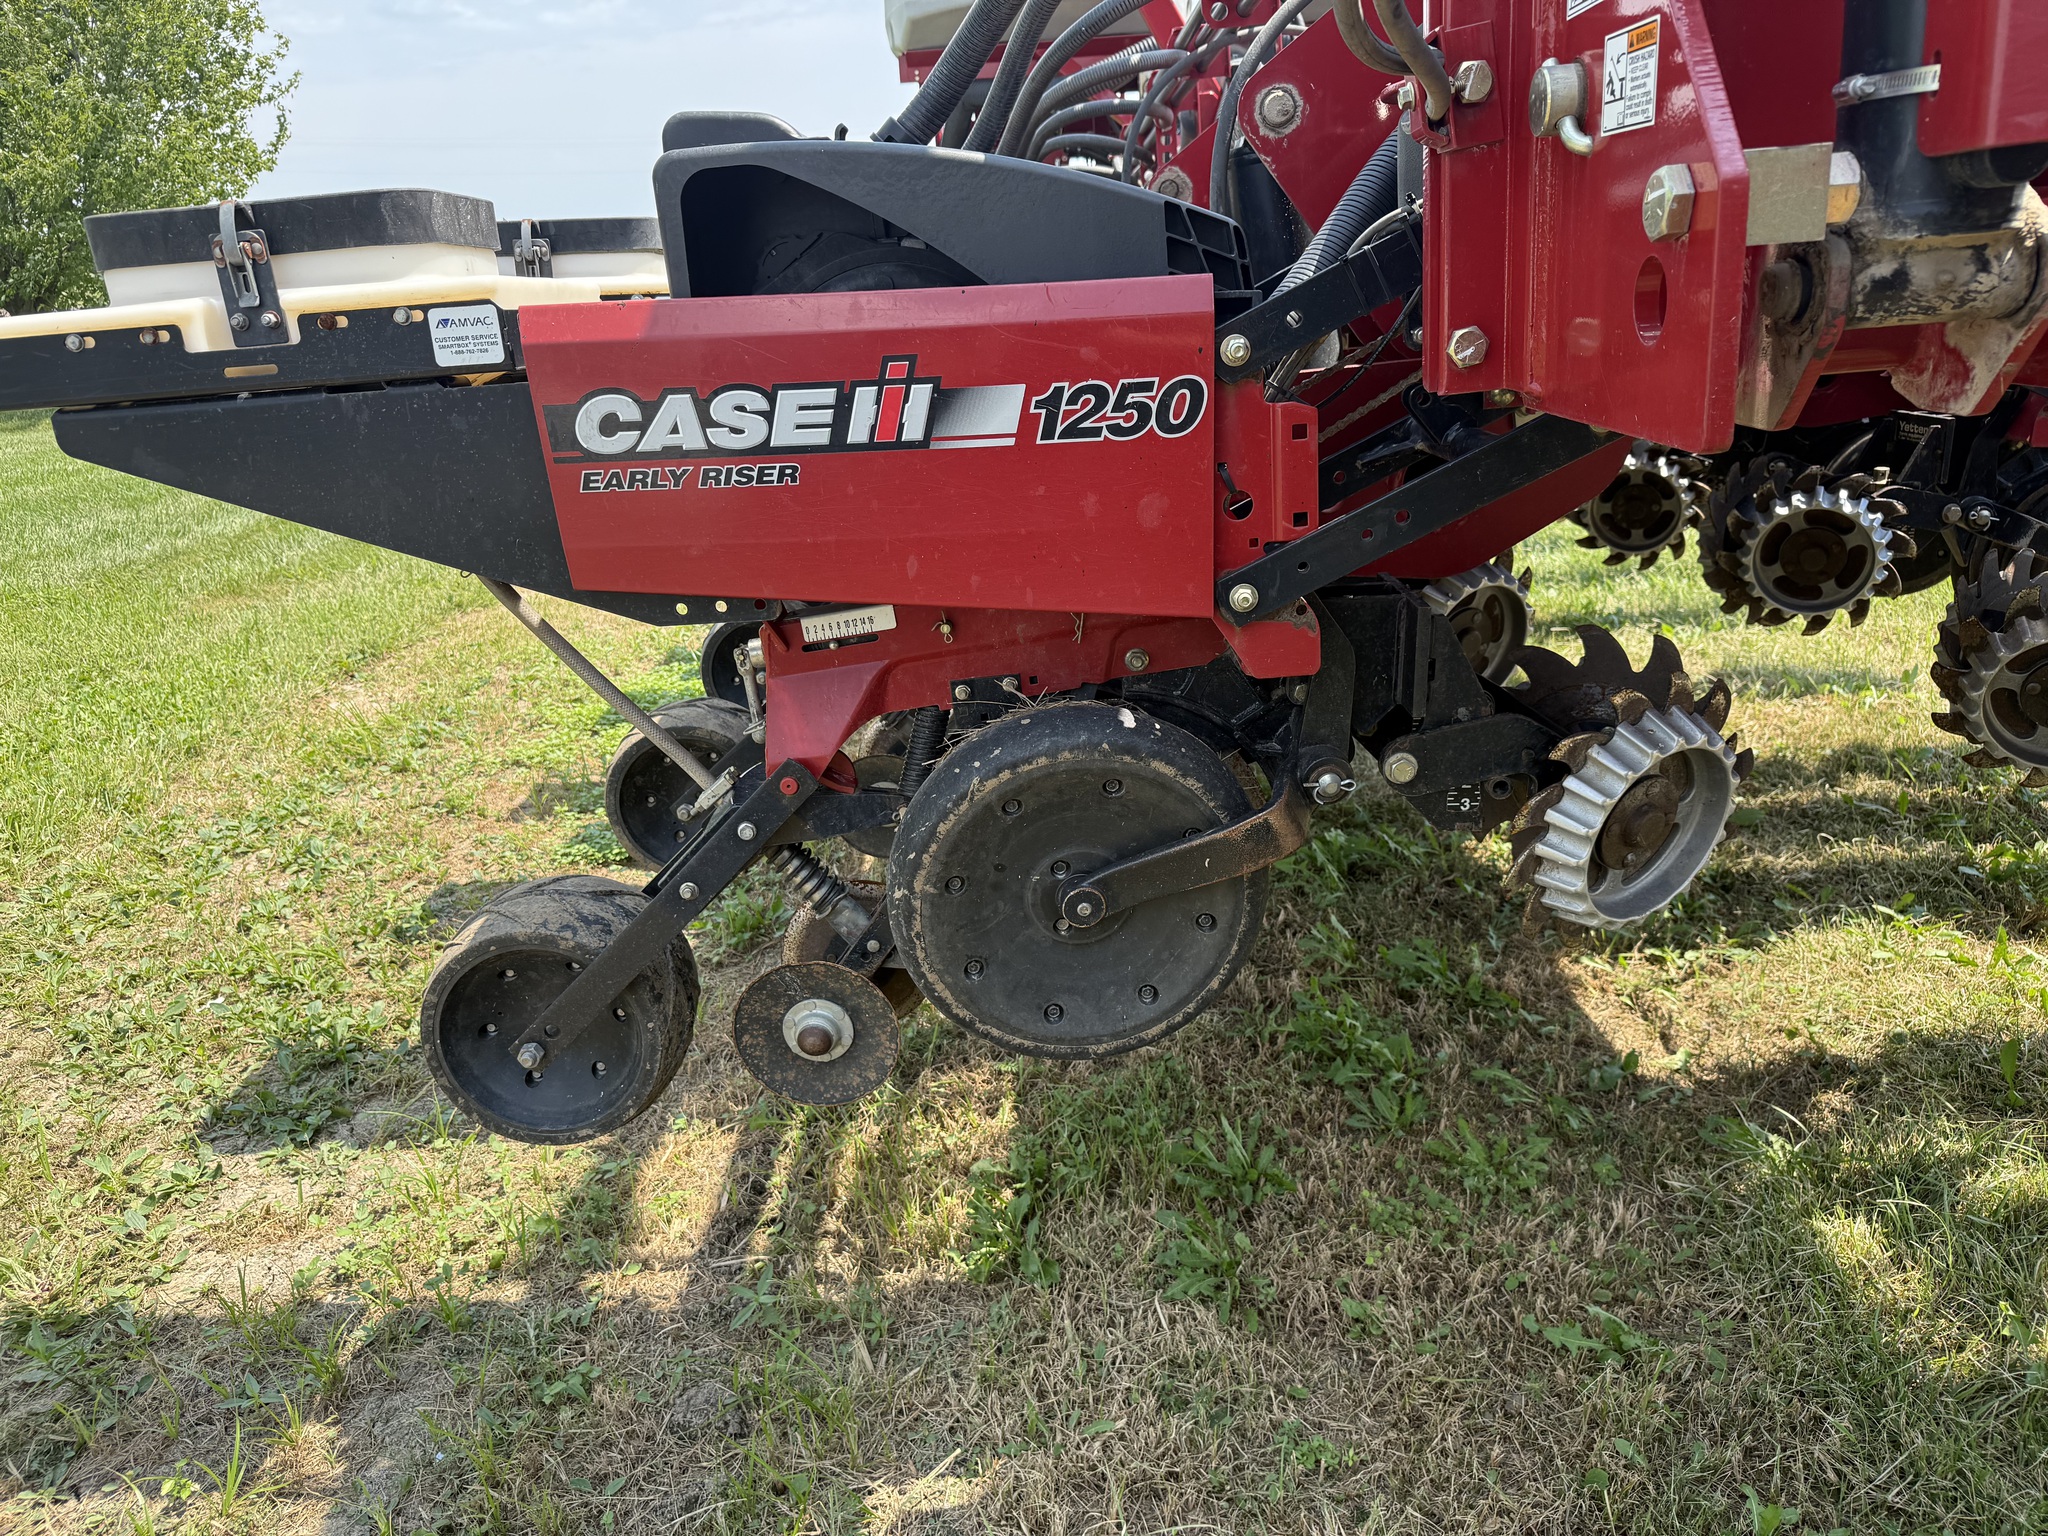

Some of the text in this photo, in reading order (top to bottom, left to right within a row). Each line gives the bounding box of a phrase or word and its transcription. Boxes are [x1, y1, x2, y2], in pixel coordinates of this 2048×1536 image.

[1636, 27, 1656, 45] WARNING
[450, 316, 492, 328] AMVAC
[1030, 376, 1208, 444] 1250
[574, 387, 838, 455] CASE
[580, 462, 801, 494] EARLY RISER
[805, 616, 874, 634] 0 2 4 6 8 10 12 14 16
[1460, 798, 1470, 811] 3
